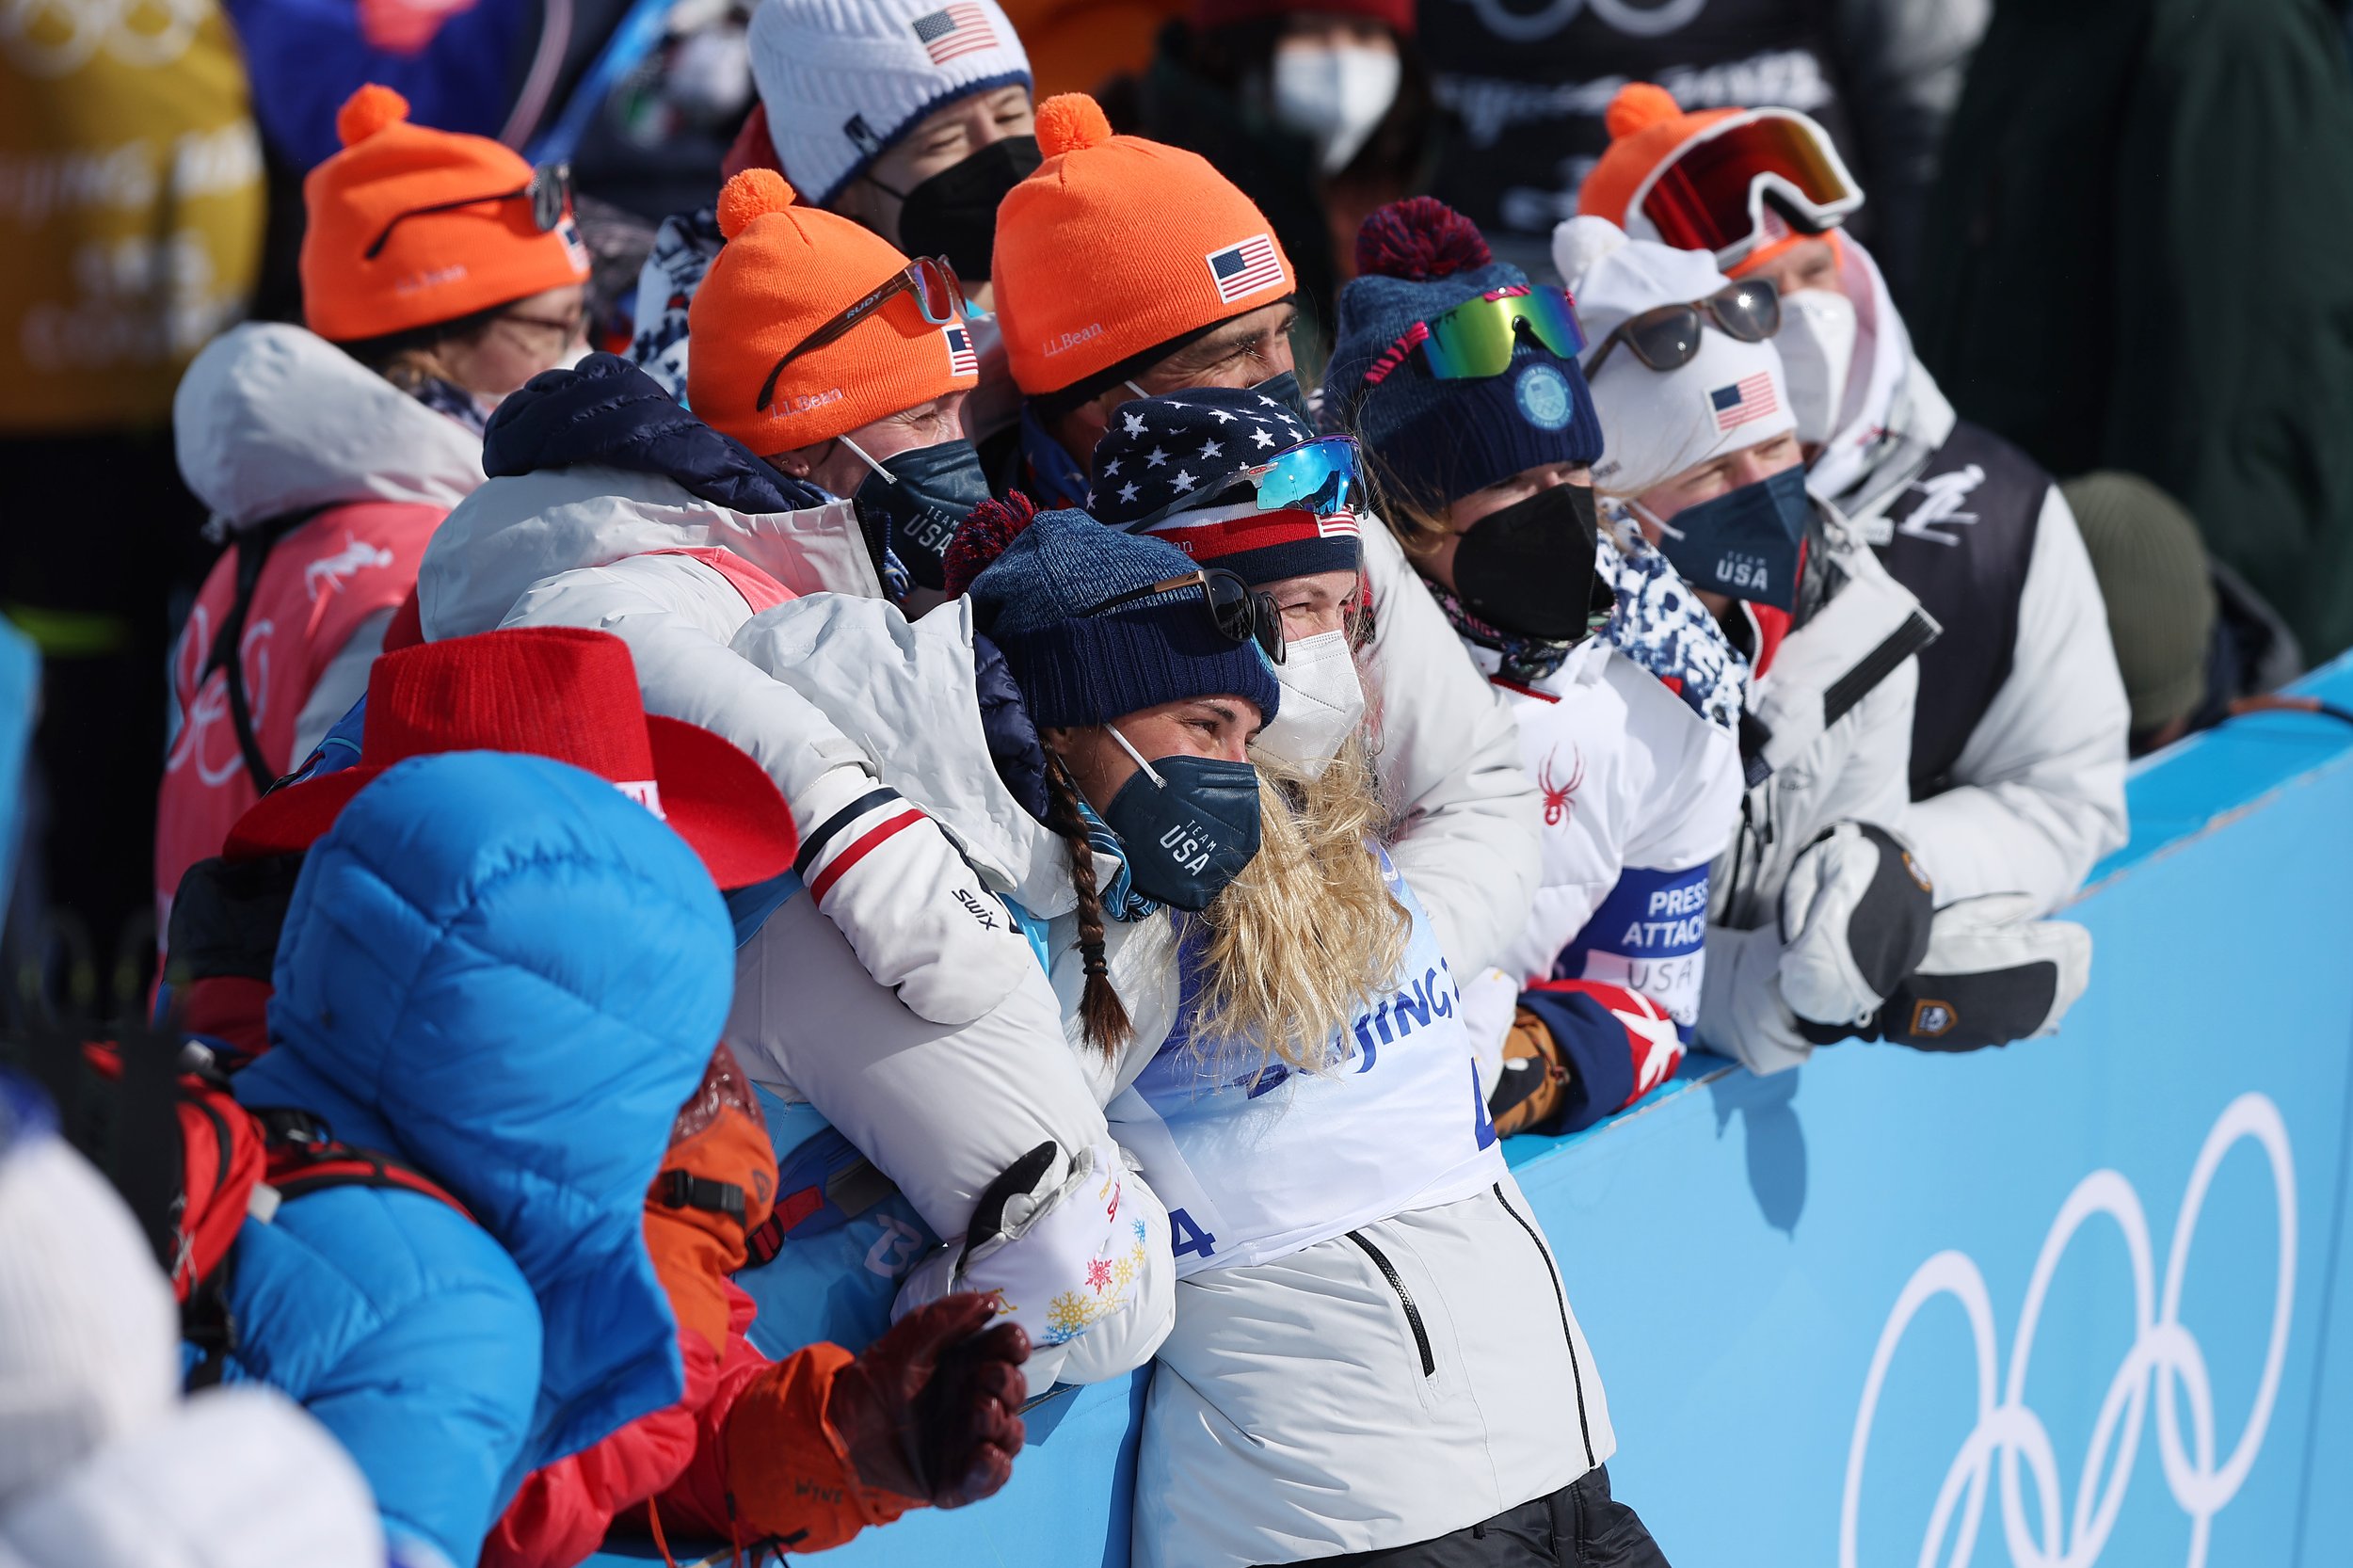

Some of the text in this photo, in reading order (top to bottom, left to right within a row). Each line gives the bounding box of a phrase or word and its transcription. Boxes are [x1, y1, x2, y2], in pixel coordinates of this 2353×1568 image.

[847, 291, 881, 319] RUDY
[1043, 323, 1101, 357] L.L.Bean
[771, 388, 842, 418] L.L.Bean
[927, 505, 959, 530] TEAM
[904, 514, 953, 557] USA
[1716, 559, 1768, 590] USA
[1160, 824, 1209, 876] USA
[1187, 820, 1217, 852] TEAM
[1627, 959, 1692, 992] USA
[1168, 1208, 1216, 1257] 4
